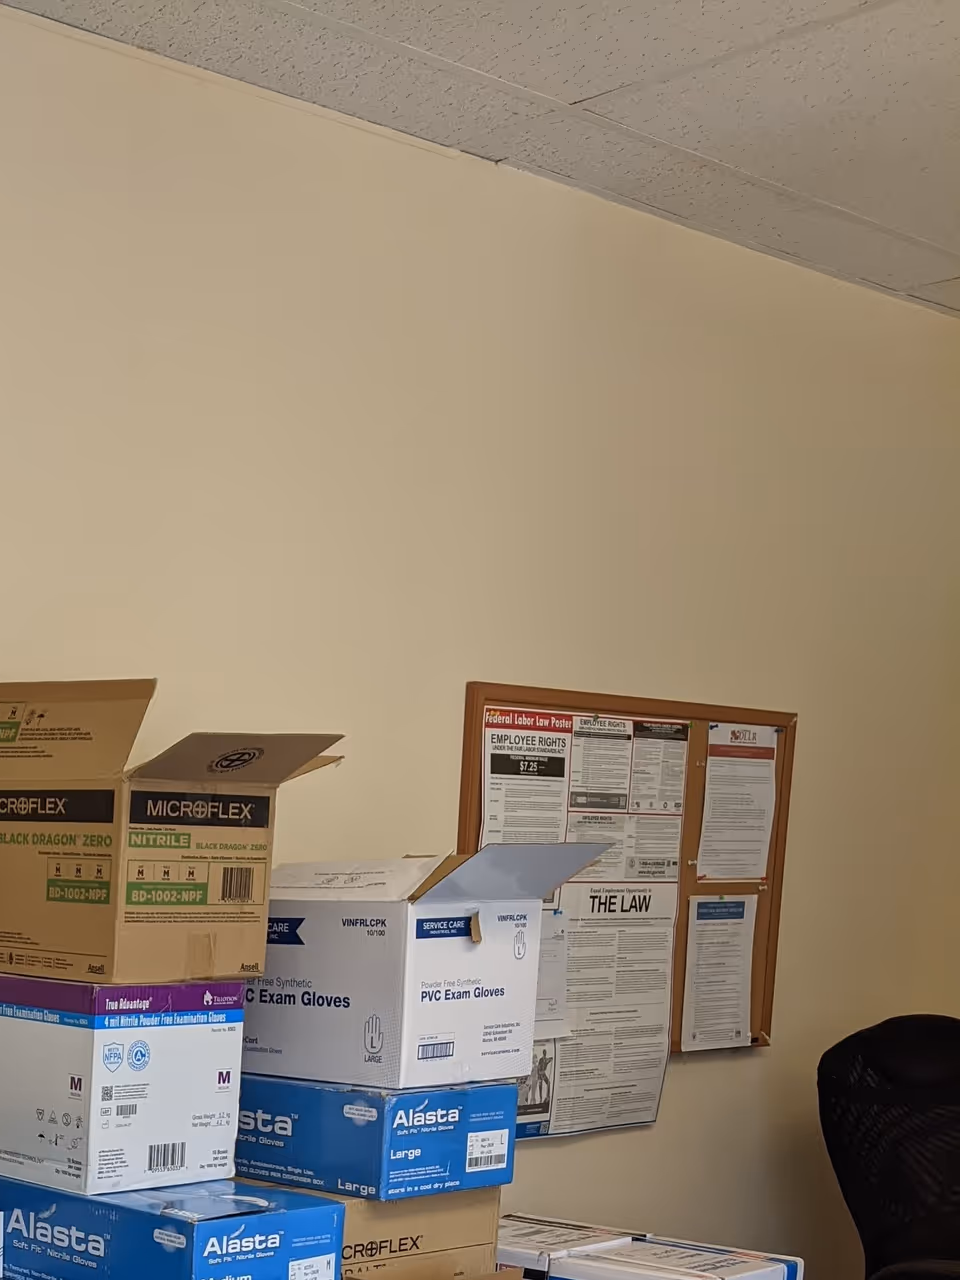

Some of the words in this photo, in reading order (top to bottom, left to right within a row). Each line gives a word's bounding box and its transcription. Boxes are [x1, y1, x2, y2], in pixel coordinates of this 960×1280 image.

[485, 713, 513, 723] Federal
[515, 714, 534, 726] Labor
[536, 716, 549, 727] Law
[551, 718, 573, 729] Poster
[580, 718, 606, 728] EMPLOYEE
[607, 719, 626, 728] RIGHTS
[491, 734, 536, 746] EMPLOYEE
[538, 737, 567, 748] RIGHTS
[520, 761, 538, 772] $7.25
[146, 799, 252, 820] MICROFLEX
[32, 833, 77, 847] DRAGON
[82, 834, 113, 848] ZERO
[130, 833, 189, 847] NITRILE
[195, 842, 218, 851] BLACK
[219, 843, 248, 851] DRAGON
[48, 886, 108, 901] BD-1002-NPF
[131, 890, 203, 903] BD-1002-NPF
[590, 895, 617, 914] THE
[620, 895, 652, 913] LAW
[342, 918, 387, 928] VINFRLCPK
[422, 921, 448, 930] SERVICE
[448, 920, 465, 929] CARE
[257, 977, 274, 986] Free
[275, 977, 312, 989] Synthetic
[421, 980, 443, 989] Powder
[443, 979, 456, 988] Free
[457, 978, 482, 987] Synthetic
[259, 989, 296, 1005] Exam
[301, 991, 351, 1008] Gloves
[421, 990, 442, 1002] PVC
[444, 989, 471, 1001] Exam
[473, 986, 505, 998] Gloves
[105, 999, 118, 1011] True
[119, 997, 150, 1011] Advantage
[104, 1017, 109, 1028] 4
[109, 1016, 119, 1027] mil
[120, 1015, 139, 1027] Nitrile
[140, 1014, 160, 1026] Powder
[161, 1013, 173, 1025] Free
[174, 1012, 208, 1025] Examination
[208, 1012, 226, 1023] Gloves
[105, 1052, 121, 1061] NFPA
[69, 1076, 83, 1092] M
[217, 1070, 231, 1085] M
[390, 1148, 422, 1160] Large
[337, 1179, 376, 1195] Large
[12, 1239, 29, 1250] Soft
[46, 1249, 71, 1262] Nitrile
[72, 1255, 98, 1269] Gloves
[341, 1236, 420, 1259] CROFLEX
